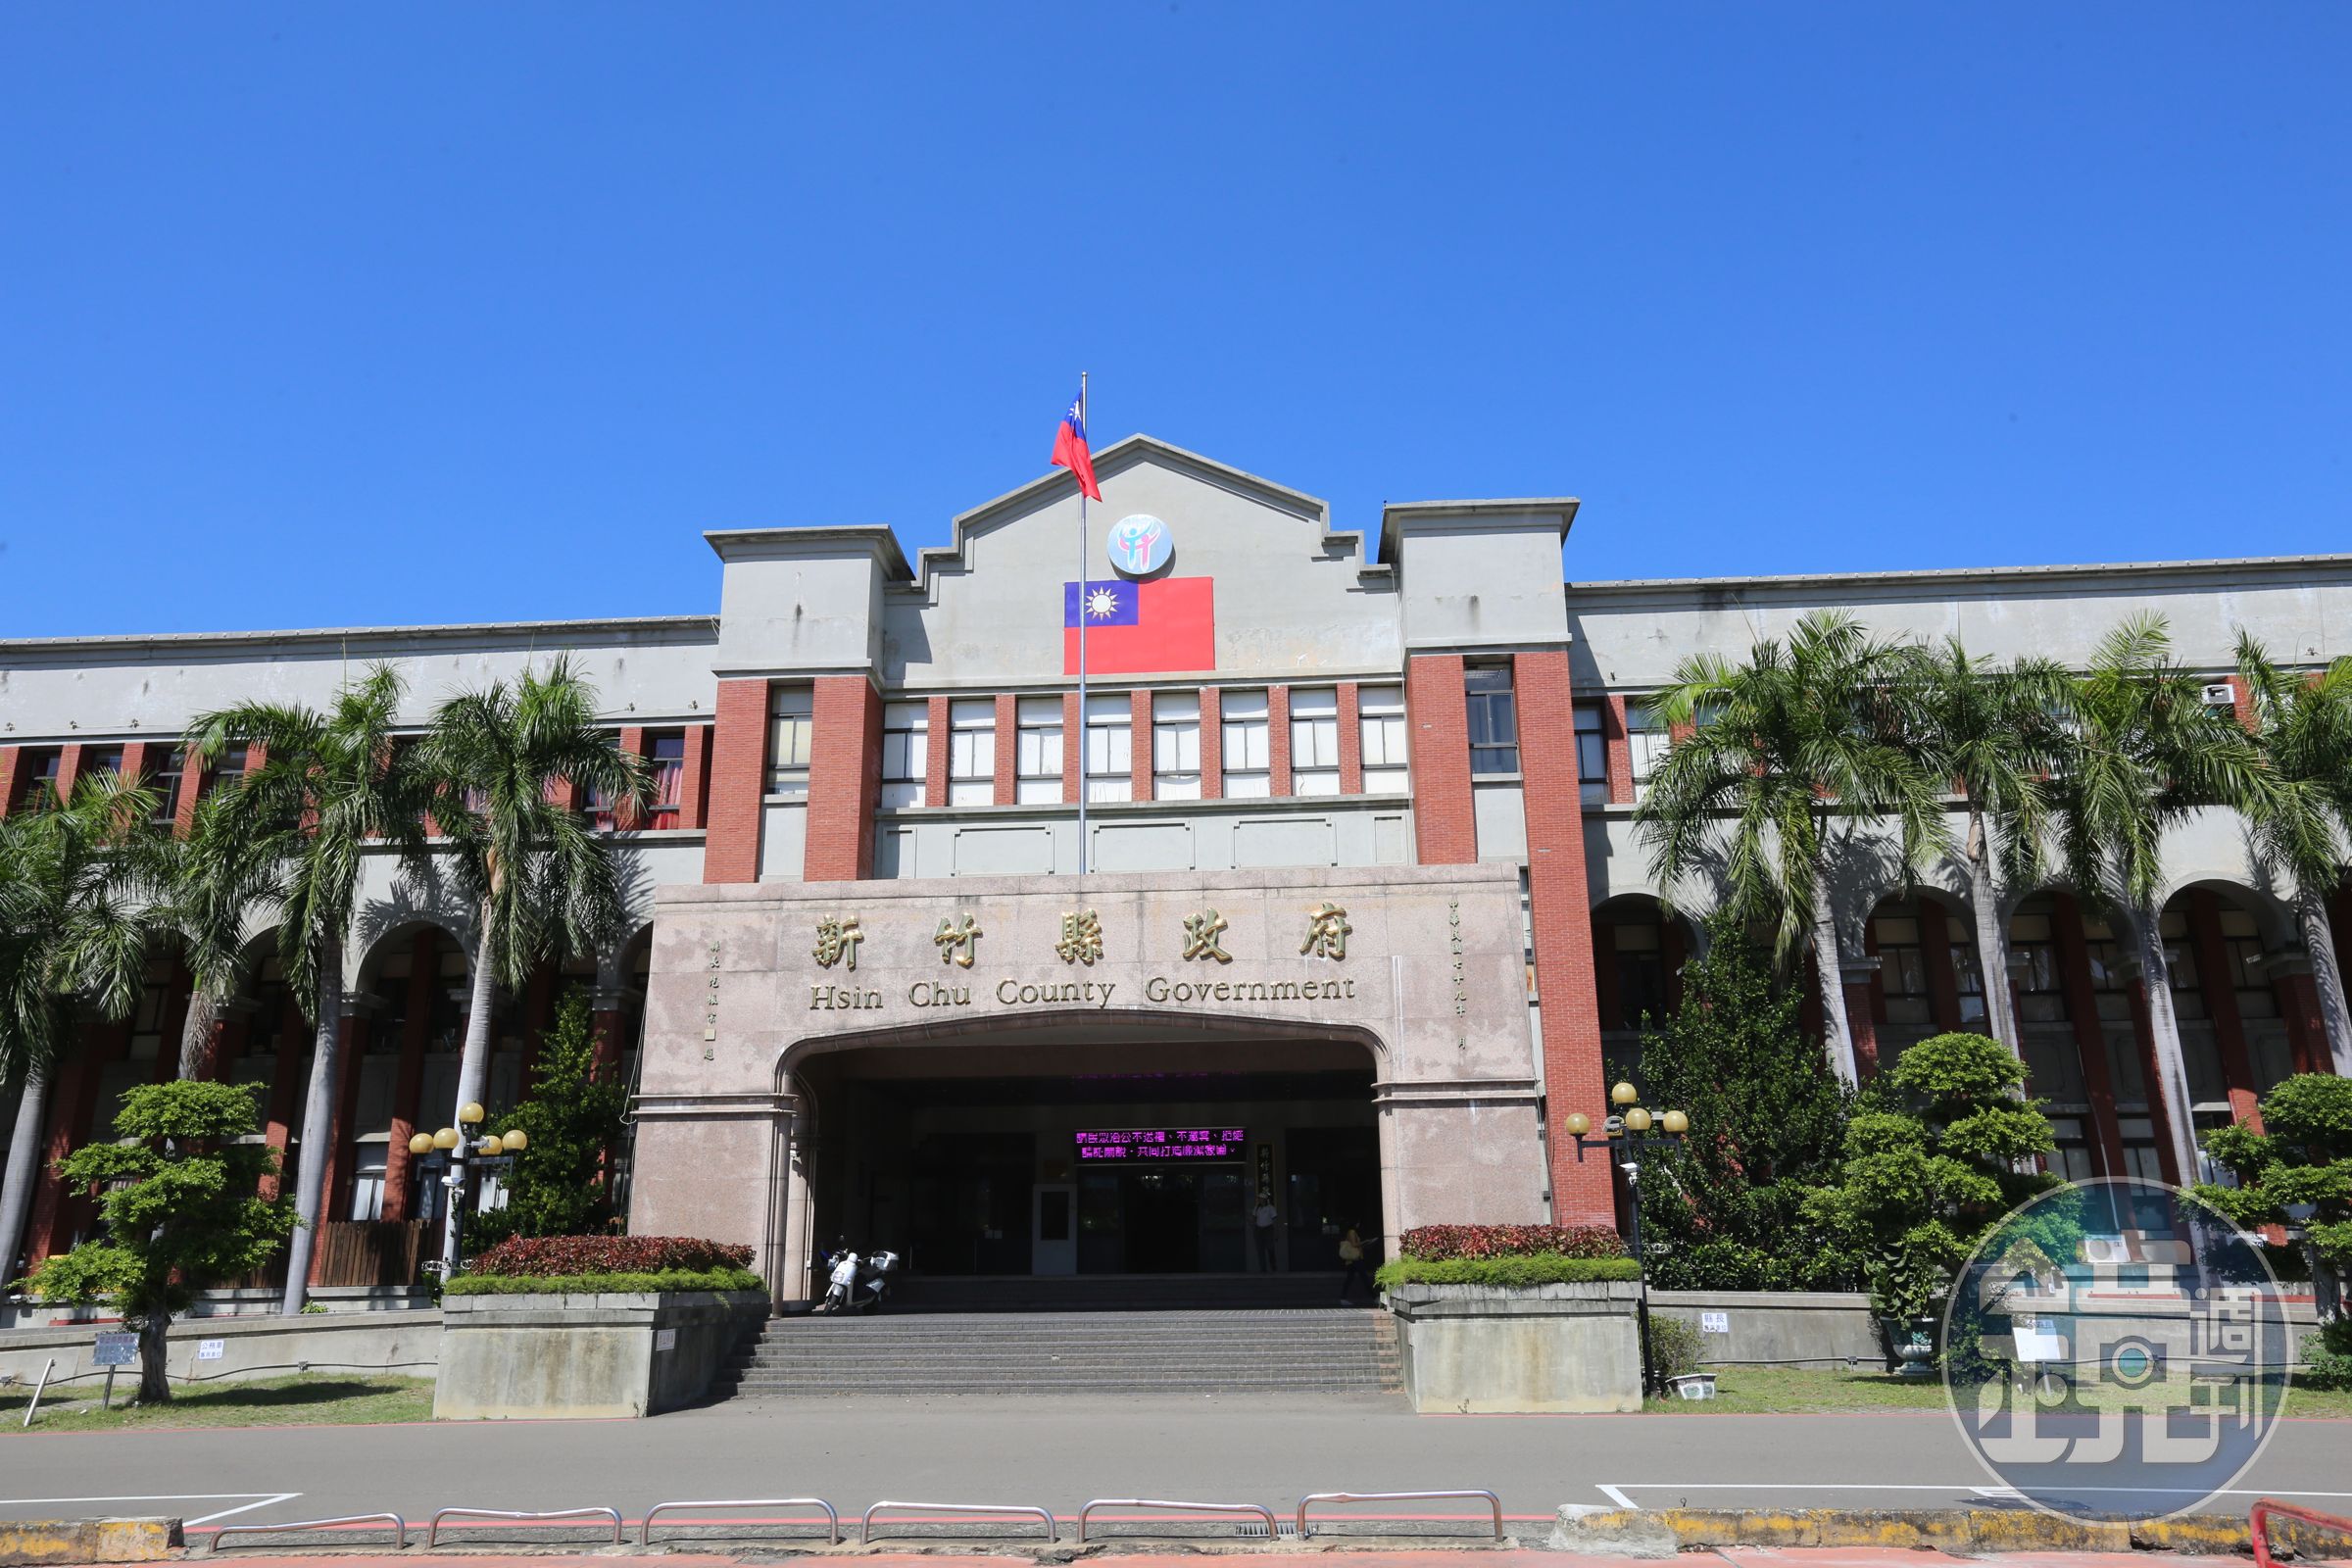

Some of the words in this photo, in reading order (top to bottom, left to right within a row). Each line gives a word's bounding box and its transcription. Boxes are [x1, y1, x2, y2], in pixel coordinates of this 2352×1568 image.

[811, 902, 1353, 970] 新竹縣政府
[809, 983, 884, 1010] Hsin
[908, 980, 971, 1006] Chu
[996, 978, 1116, 1009] County
[1145, 976, 1355, 1003] Government
